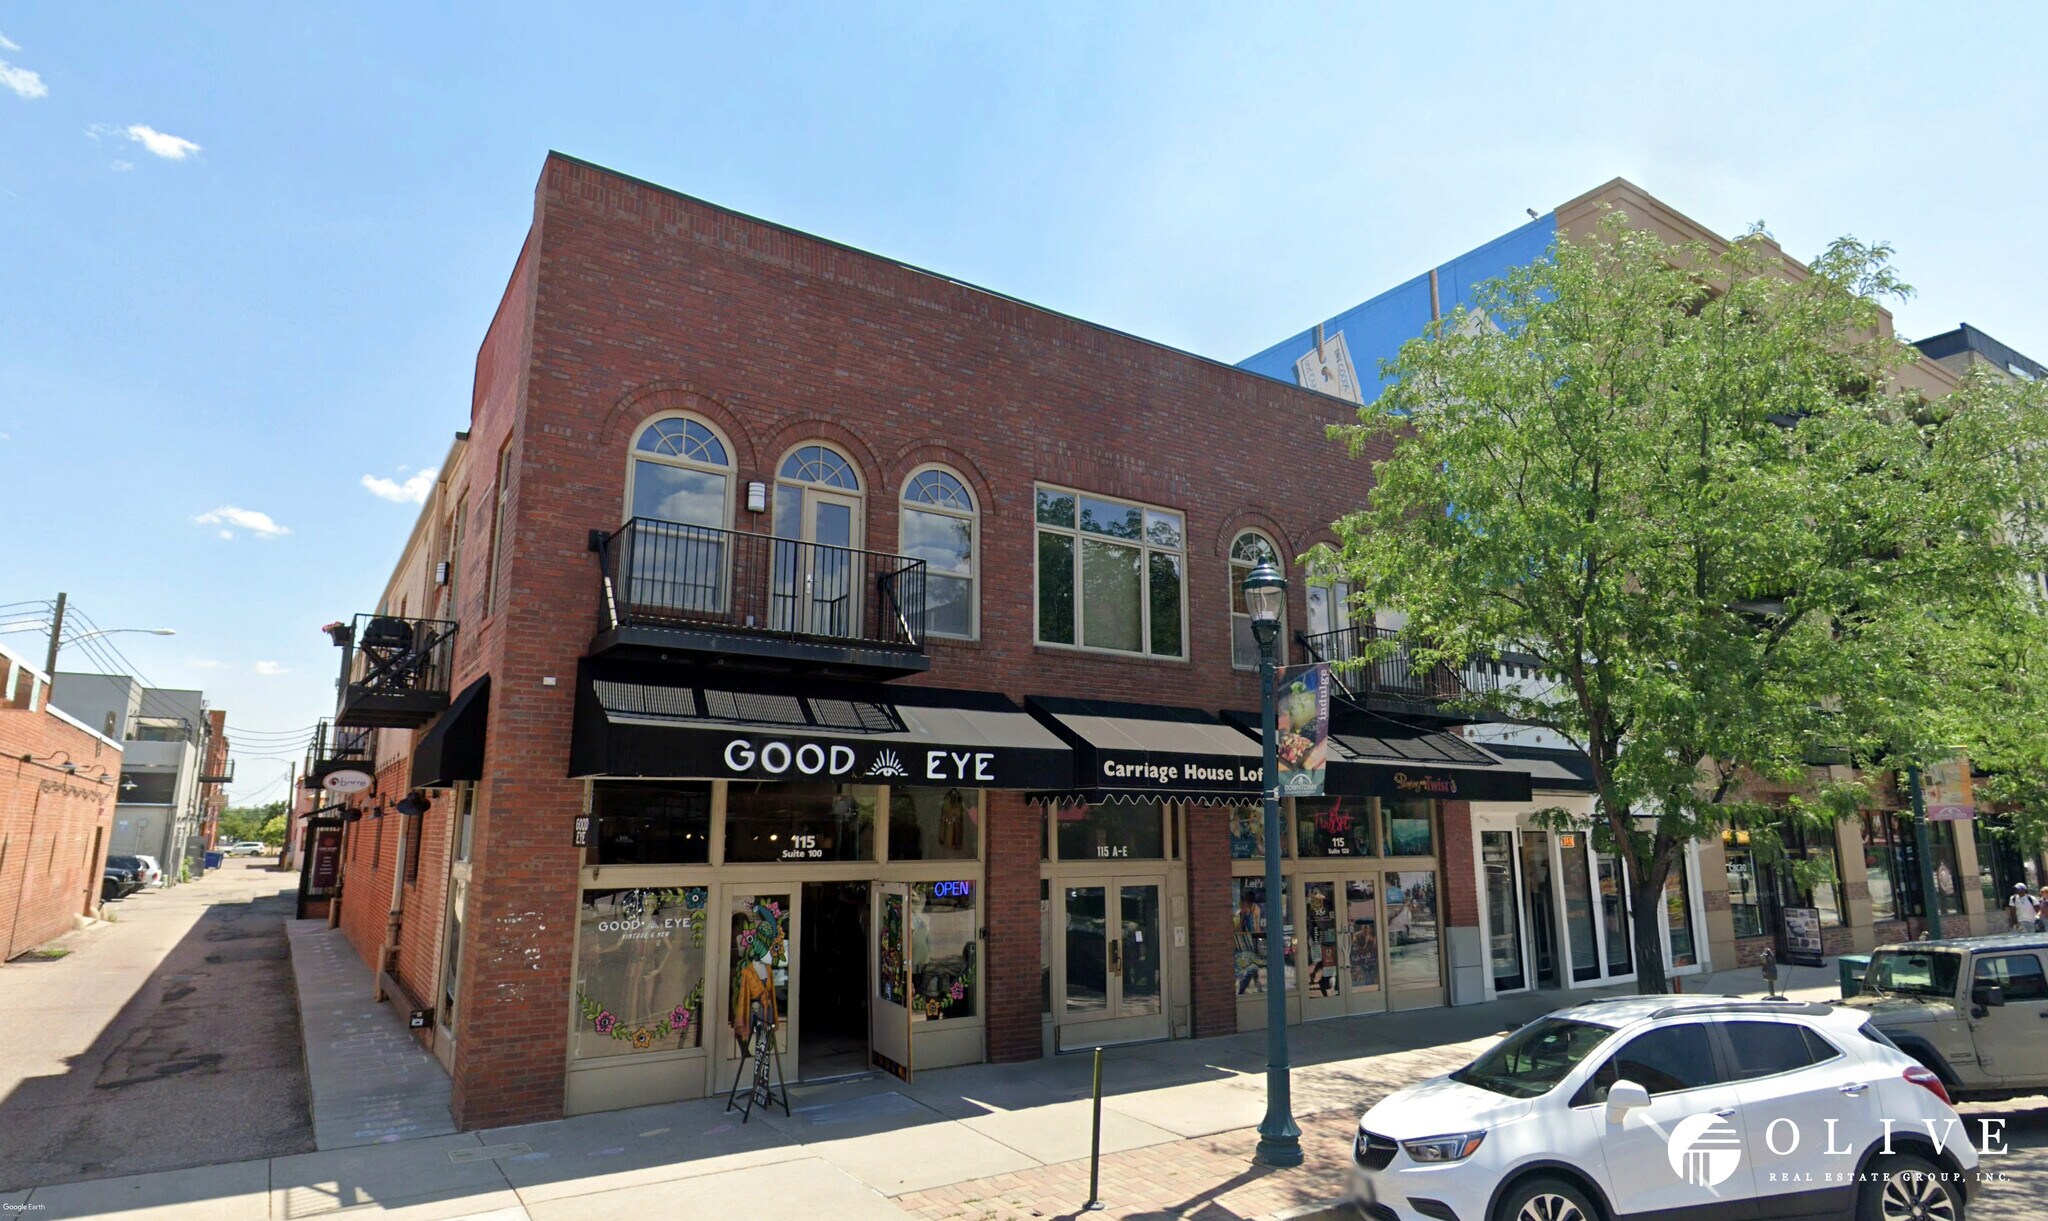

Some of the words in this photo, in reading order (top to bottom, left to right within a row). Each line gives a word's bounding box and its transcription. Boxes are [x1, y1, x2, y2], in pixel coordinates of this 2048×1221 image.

[1319, 669, 1329, 720] indulge
[724, 740, 855, 775] GOOD
[927, 751, 995, 781] EYE
[1103, 760, 1178, 783] Carriage
[1184, 764, 1234, 781] House
[1239, 766, 1264, 782] Lof
[1424, 776, 1450, 792] Twist
[576, 818, 589, 831] GOOD
[576, 831, 586, 844] EYE
[795, 836, 816, 848] 115
[1332, 837, 1345, 847] 115
[782, 850, 805, 858] Suite
[808, 850, 822, 858] 100
[1097, 846, 1109, 857] 115
[1112, 846, 1128, 857] A-E
[934, 881, 969, 897] OPEN
[598, 920, 640, 932] GOOD
[665, 918, 691, 929] EYE
